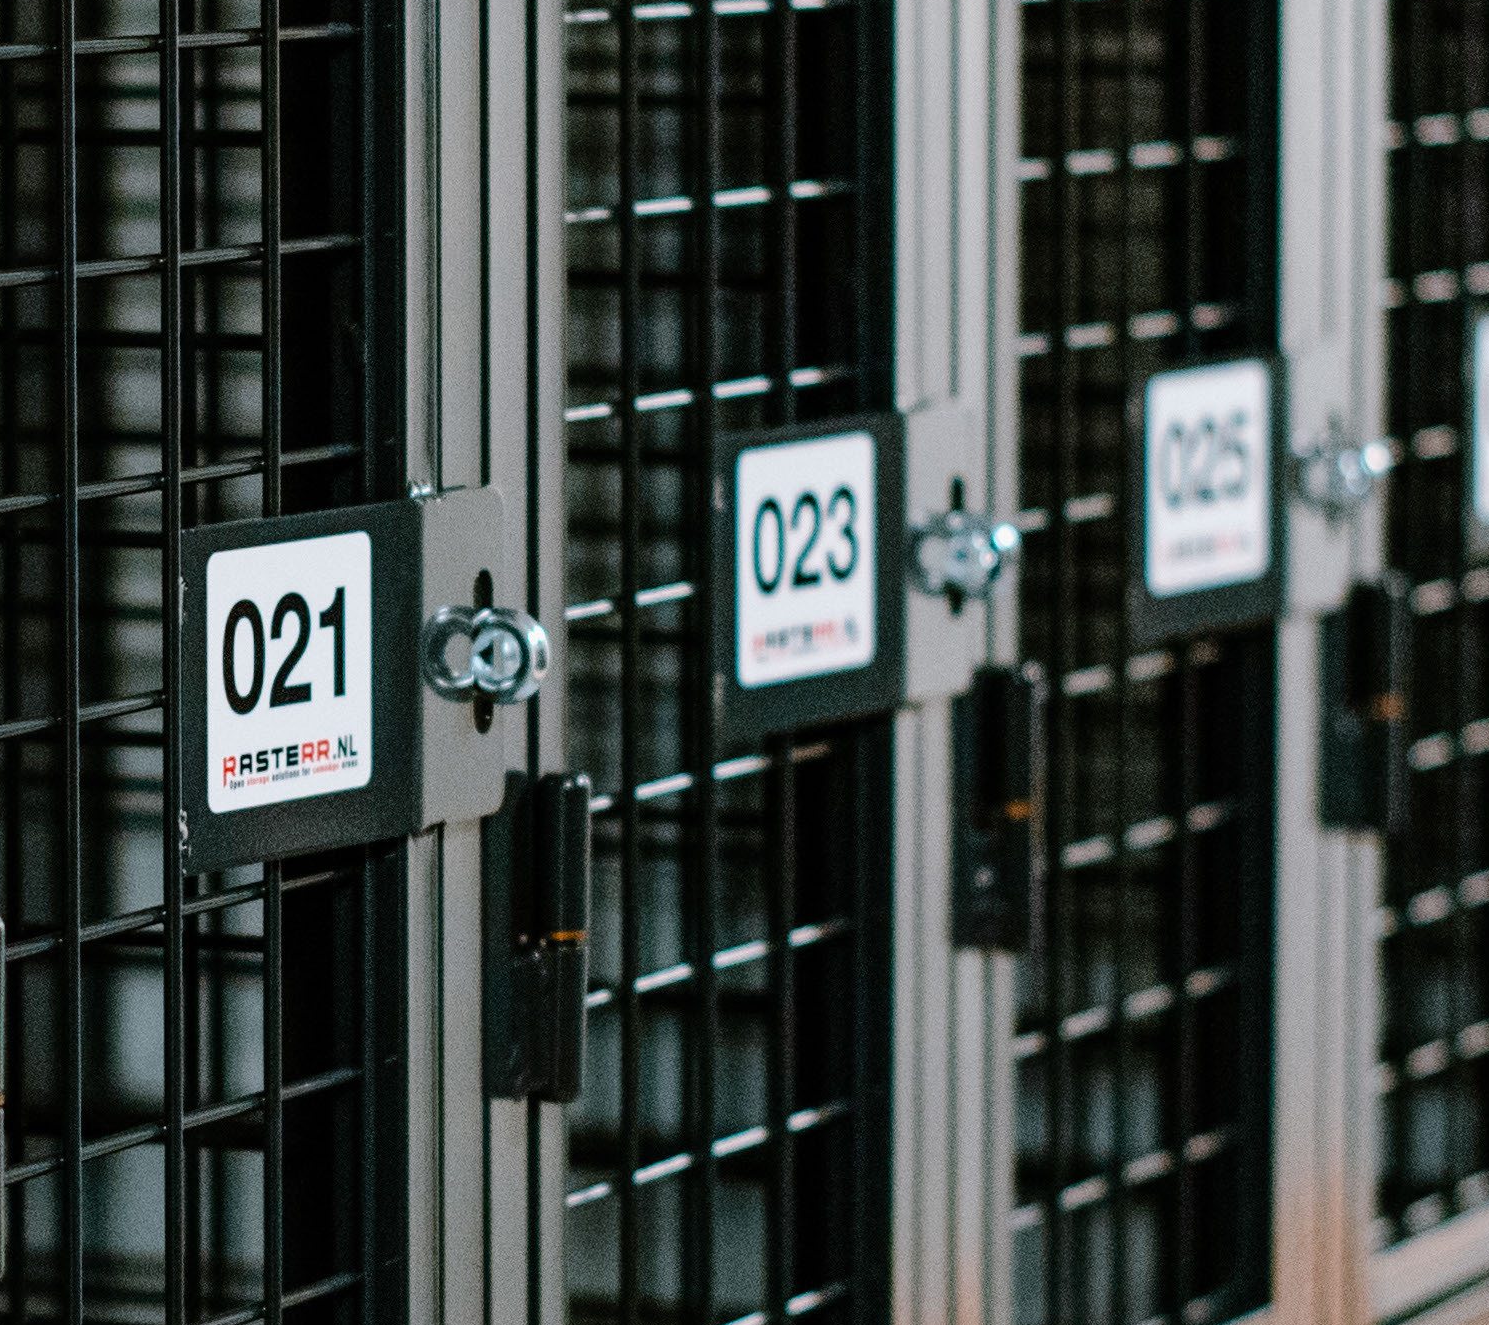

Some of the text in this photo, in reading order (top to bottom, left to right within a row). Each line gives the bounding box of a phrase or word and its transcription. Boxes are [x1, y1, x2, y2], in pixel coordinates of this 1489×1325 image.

[1164, 409, 1250, 506] 025
[753, 485, 859, 595] 023
[222, 585, 346, 715] 021
